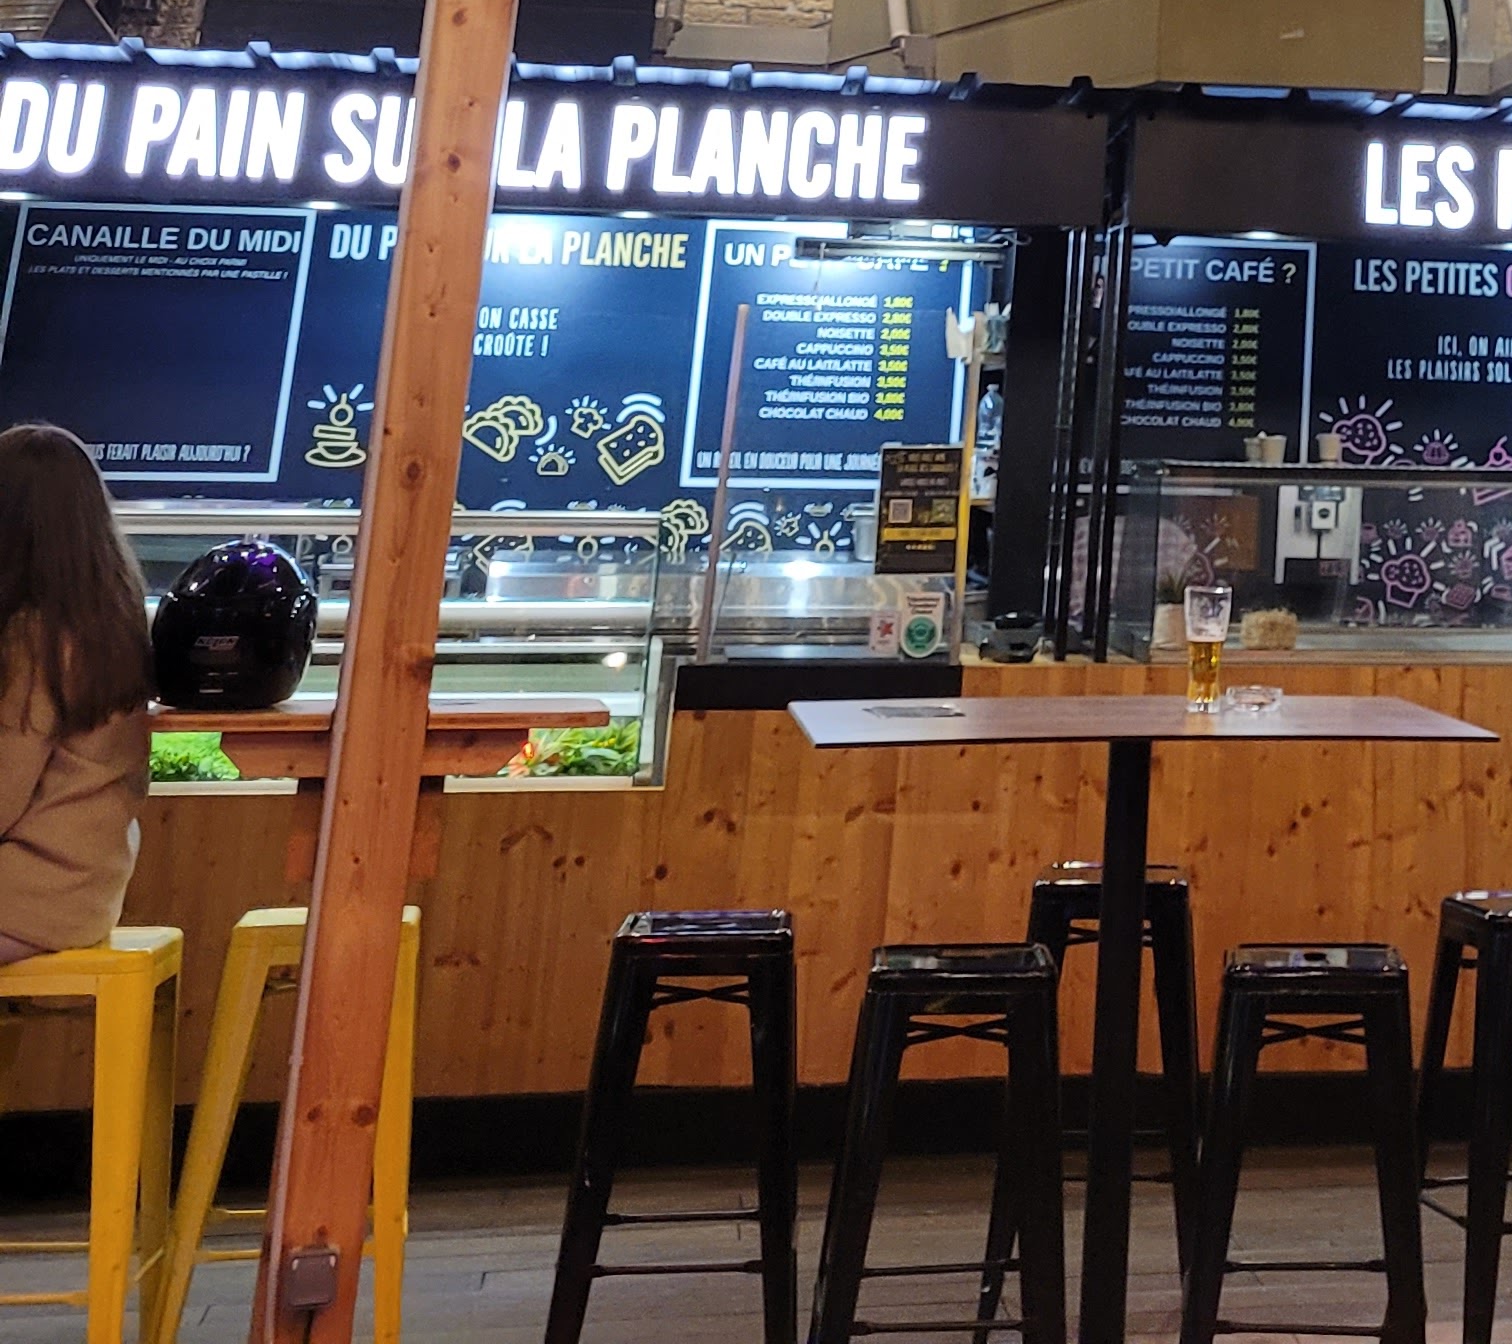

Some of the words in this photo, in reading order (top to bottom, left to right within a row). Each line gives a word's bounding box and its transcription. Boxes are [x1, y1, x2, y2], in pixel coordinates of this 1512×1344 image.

[0, 78, 106, 173] DU
[125, 82, 305, 183] PAIN
[323, 92, 418, 186] SU
[495, 99, 582, 191] LA
[606, 103, 927, 202] PLANCHE
[1362, 141, 1476, 230] LES
[27, 223, 180, 250] CANAILLE
[187, 228, 231, 251] DU
[238, 230, 301, 254] MIDI
[329, 223, 373, 261] DU
[561, 230, 689, 269] PLANCHE
[724, 242, 766, 266] UN
[1130, 258, 1200, 280] PETIT
[1205, 256, 1275, 283] CAFÉ
[1282, 262, 1297, 284] ?
[1353, 257, 1398, 293] LES
[1404, 260, 1499, 297] PETITES
[508, 307, 560, 331] CASSE
[762, 310, 812, 323] DOUBLE
[813, 311, 877, 324] EXPRESSO
[816, 327, 876, 341] NOISETTE
[1128, 320, 1166, 333] OUBLE
[1167, 321, 1227, 334] EXPRESSO
[472, 332, 535, 357] CROÛTE
[796, 342, 875, 356] CAPPUCCINO
[1171, 337, 1226, 350] NOISETTE
[1468, 336, 1489, 358] ON
[754, 355, 788, 371] CAFÉ
[788, 359, 807, 372] AU
[1152, 352, 1226, 364] CAPPUCCINO
[1145, 368, 1162, 379] AU
[1387, 359, 1412, 380] LES
[1418, 360, 1481, 383] PLAISIRS
[847, 391, 870, 405] BIO
[758, 406, 826, 420] CHOCOLAT
[825, 407, 869, 421] CHAUD
[1202, 401, 1222, 413] BIO
[1181, 416, 1222, 428] CHAUD
